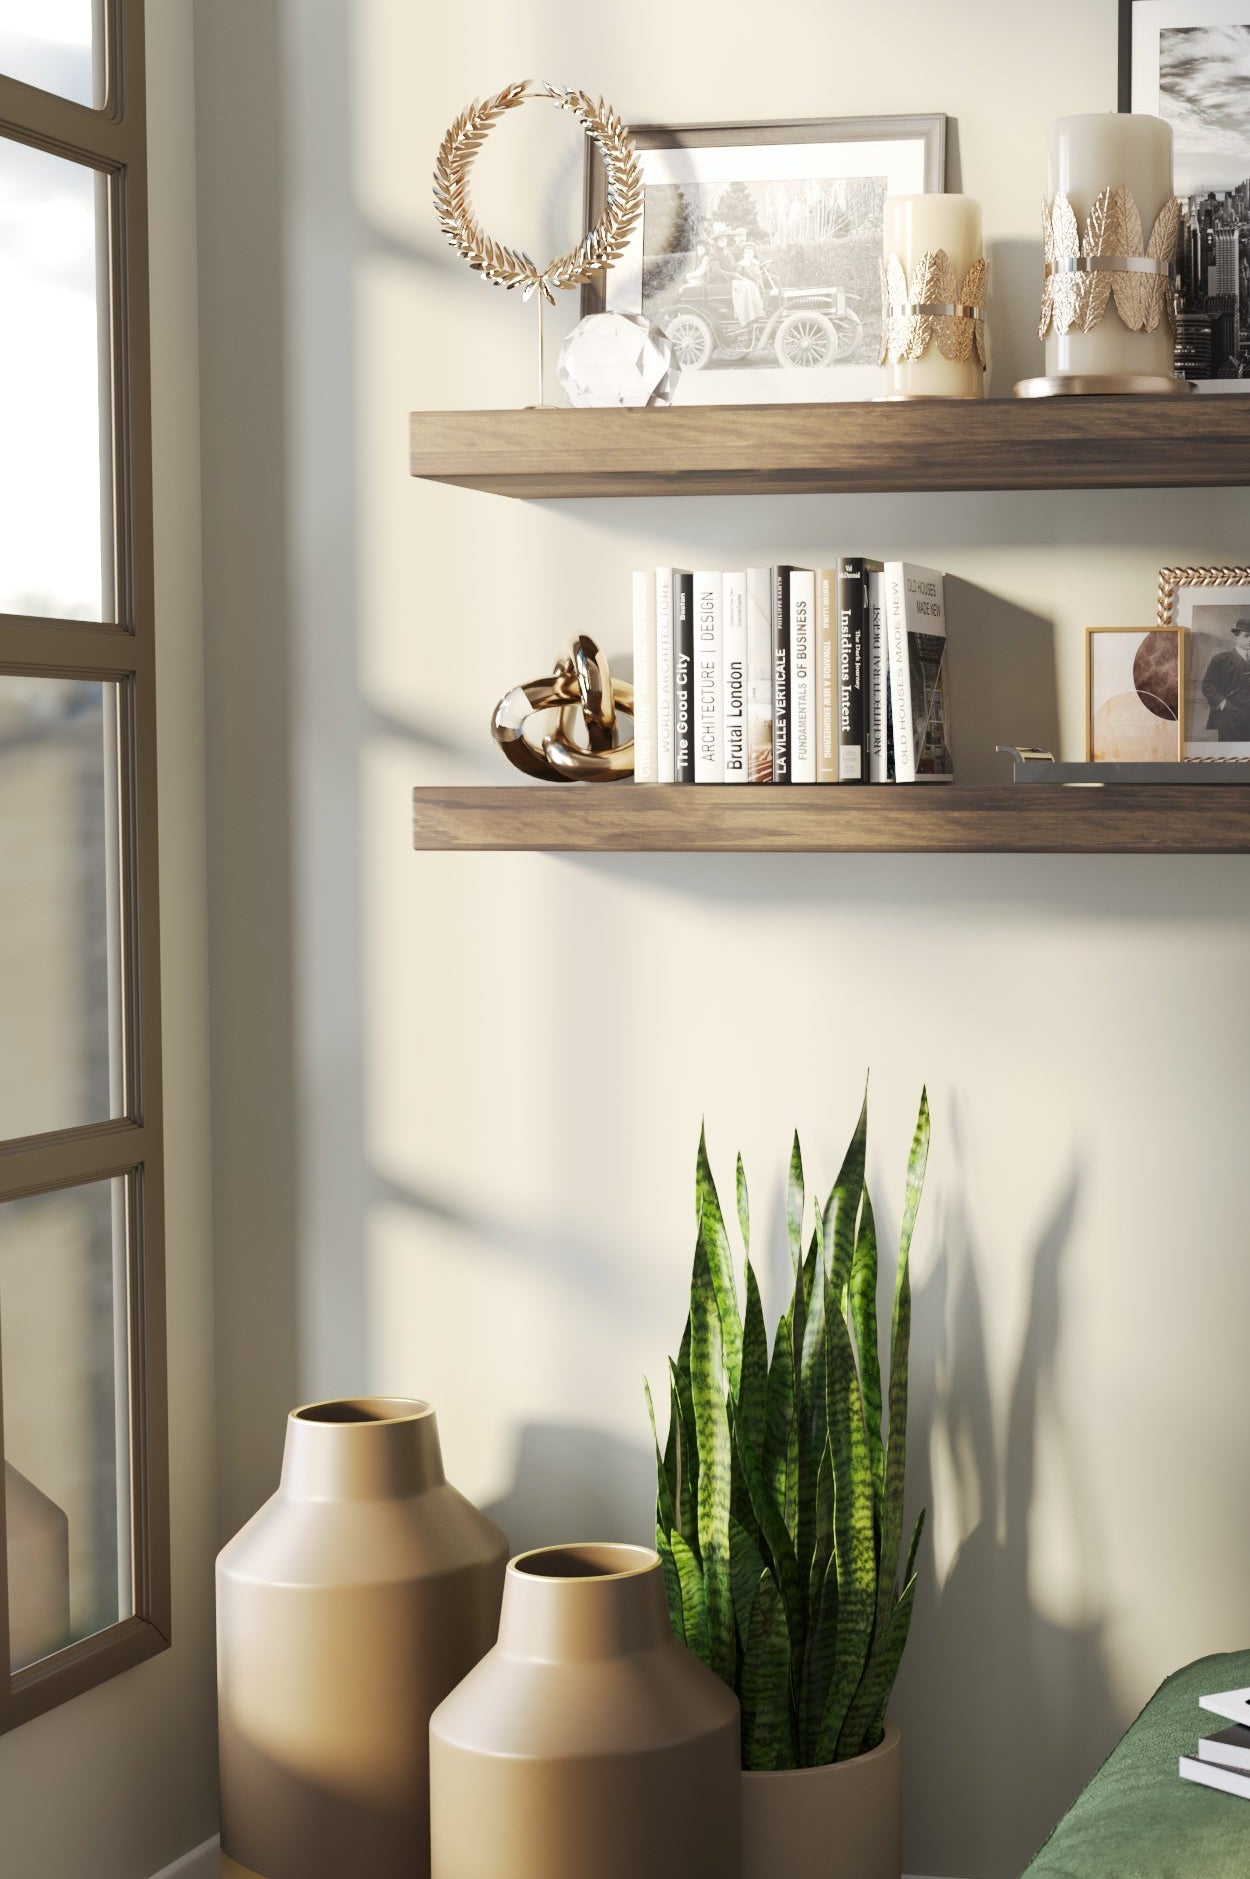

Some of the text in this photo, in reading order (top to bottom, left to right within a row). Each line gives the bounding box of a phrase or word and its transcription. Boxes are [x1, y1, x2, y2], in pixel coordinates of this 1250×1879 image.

[661, 580, 671, 754] WORLD ARCHITECTURE
[677, 652, 691, 769] The Good City
[701, 591, 715, 762] ARCHITECTURE DESIGN
[728, 661, 743, 770] Brutal London
[775, 648, 787, 774] LA VILLE VERTICALE
[797, 600, 807, 761] FUNDAMENTALS OF BUSINESS
[824, 640, 832, 678] TOWARDS
[824, 688, 832, 707] NEW
[841, 609, 852, 732] Insidious Intent
[872, 603, 882, 758] ARCHITECTURAL DIGEST
[891, 580, 909, 765] OLD HOUSES MADE NEW
[824, 708, 832, 759] ENGINEERING
